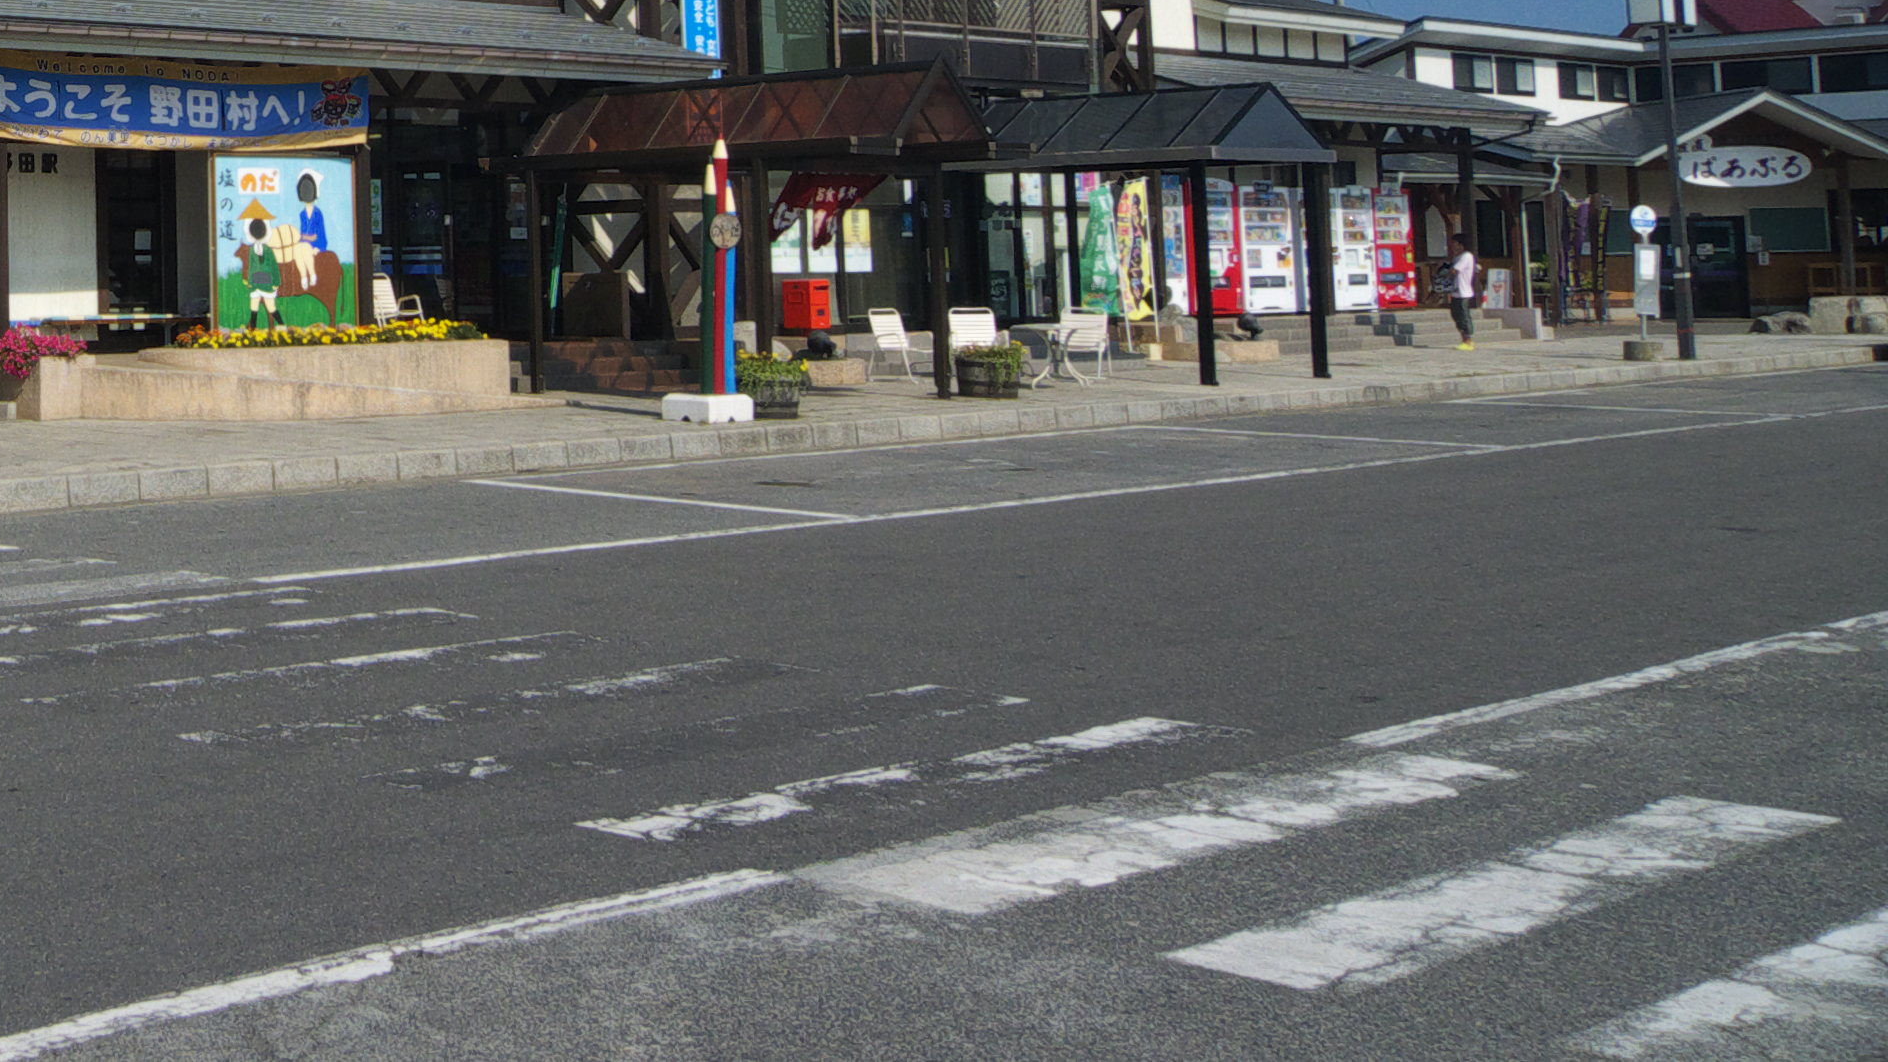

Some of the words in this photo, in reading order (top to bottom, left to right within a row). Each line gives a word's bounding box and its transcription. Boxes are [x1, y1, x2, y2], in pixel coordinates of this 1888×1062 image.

[36, 58, 125, 75] Welcome
[144, 64, 165, 77] to
[240, 170, 278, 192] のだ
[218, 168, 237, 241] 塩の道
